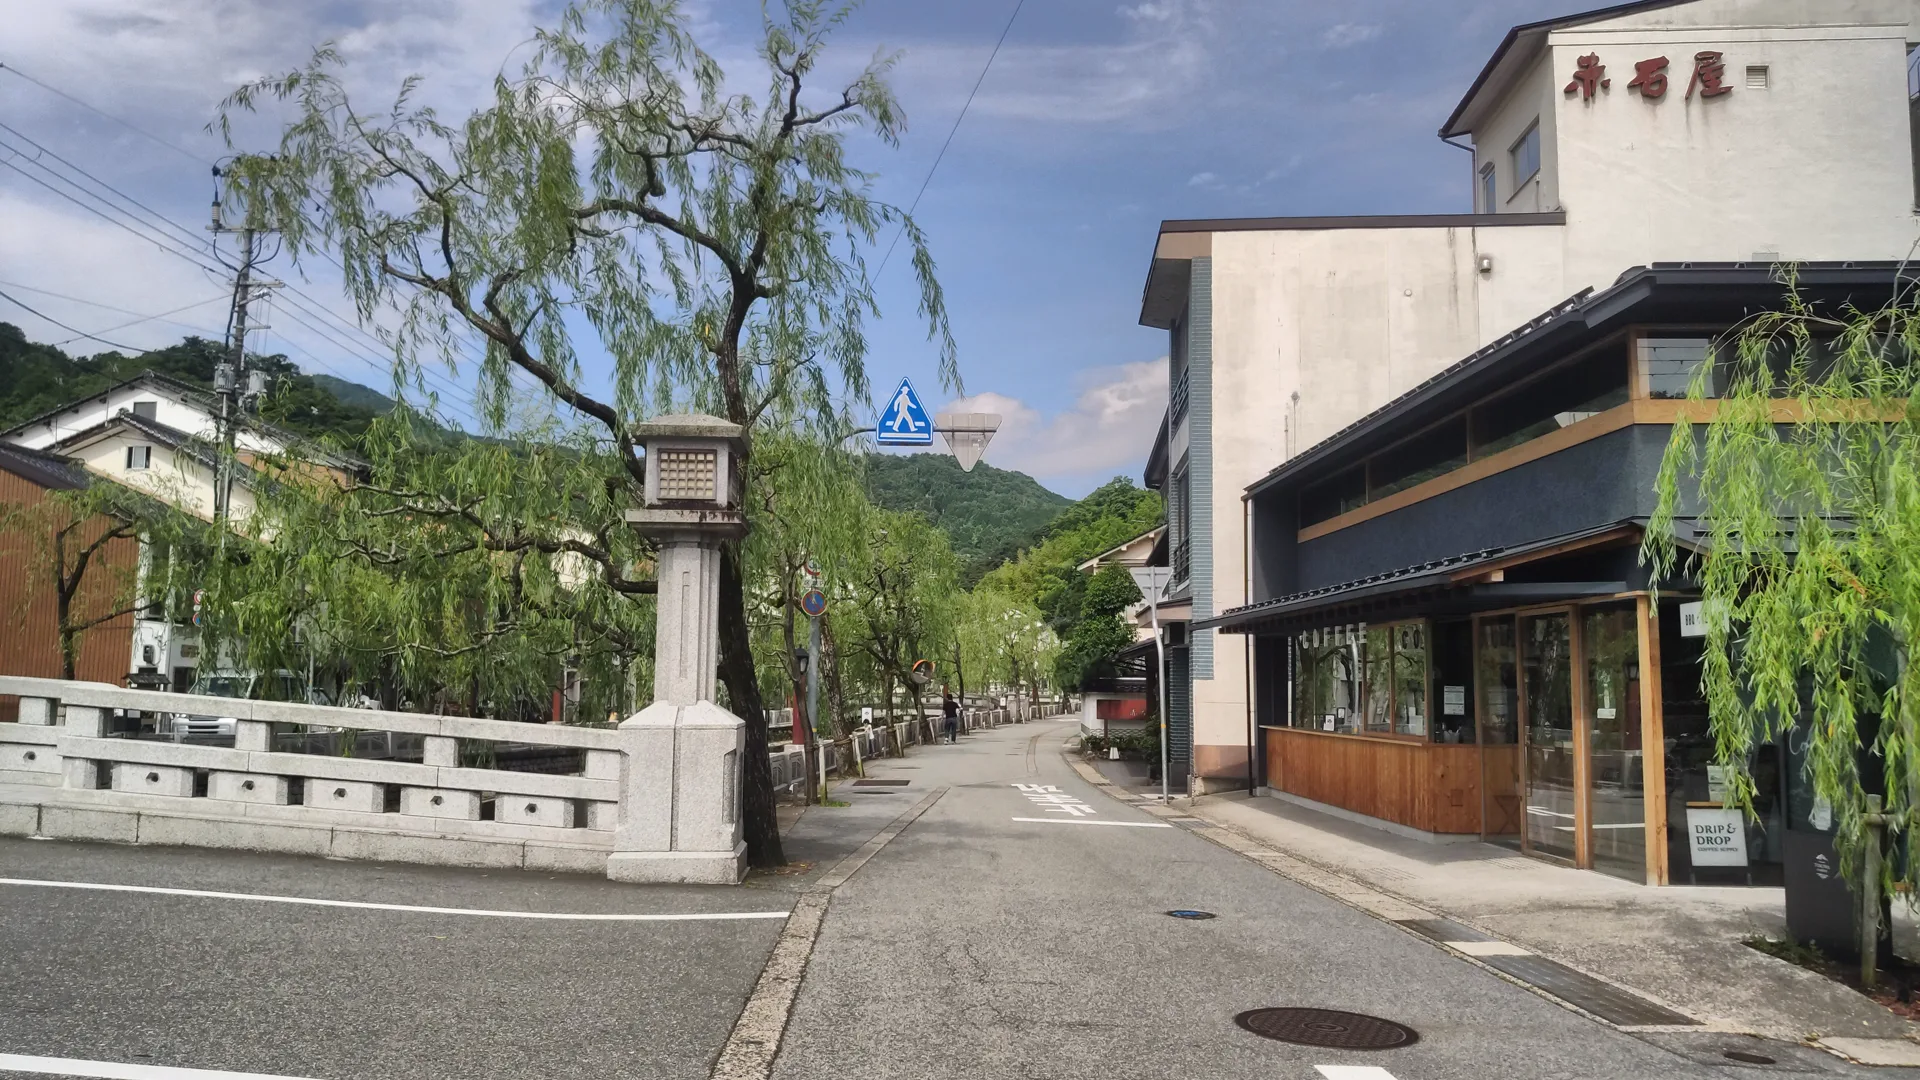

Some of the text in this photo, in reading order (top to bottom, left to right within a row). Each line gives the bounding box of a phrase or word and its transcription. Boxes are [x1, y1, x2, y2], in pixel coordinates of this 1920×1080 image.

[1302, 621, 1367, 649] COFFEE
[1694, 822, 1737, 834] DRIP &
[1696, 836, 1731, 845] DROP
